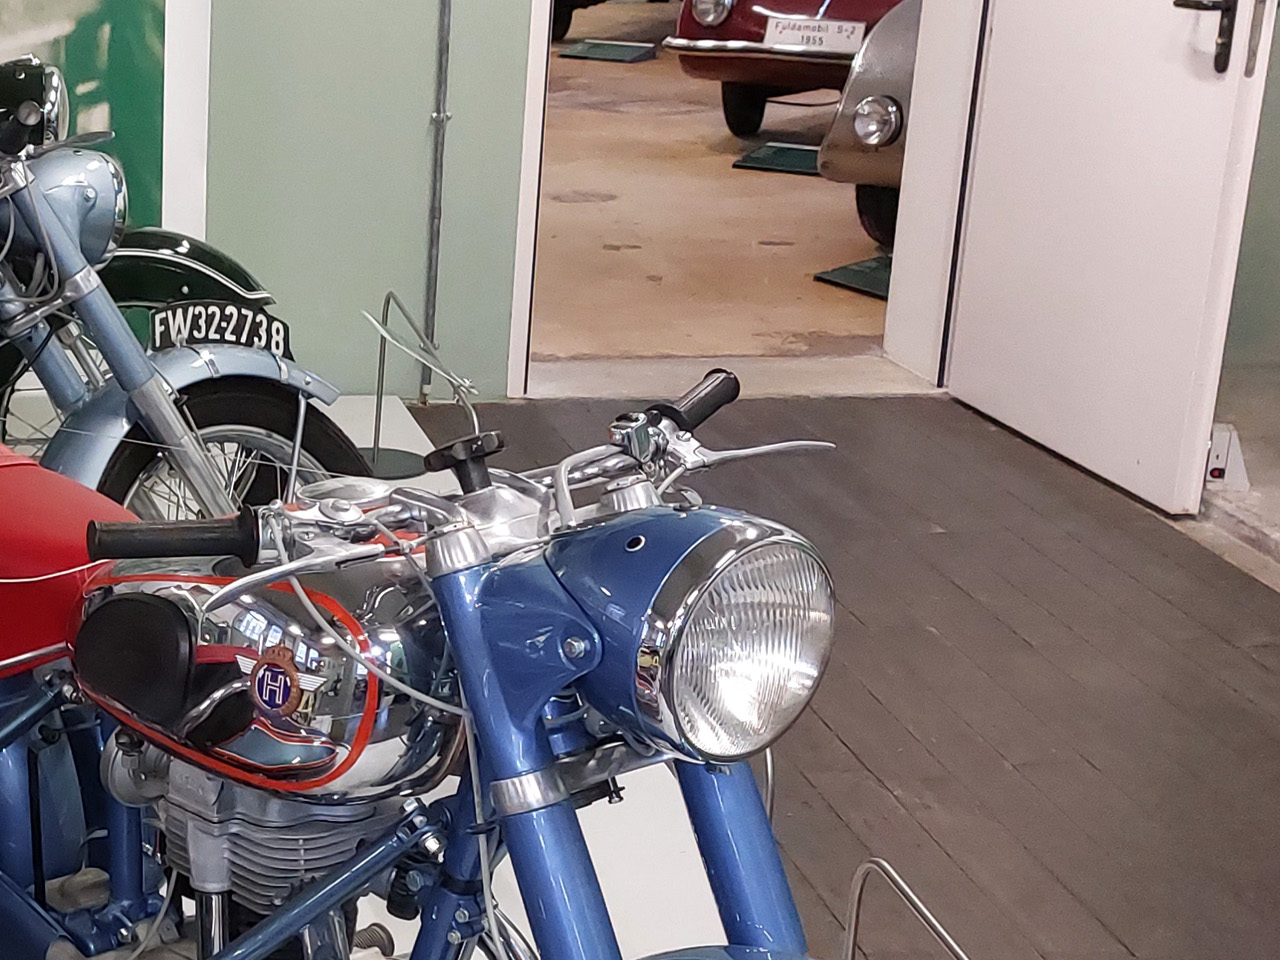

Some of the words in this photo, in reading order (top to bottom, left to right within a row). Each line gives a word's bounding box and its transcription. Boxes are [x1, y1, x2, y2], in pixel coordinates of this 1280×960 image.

[775, 21, 829, 34] Fuldamobil
[800, 35, 824, 46] 1955
[154, 304, 285, 357] FW32-2738
[262, 671, 285, 705] H
